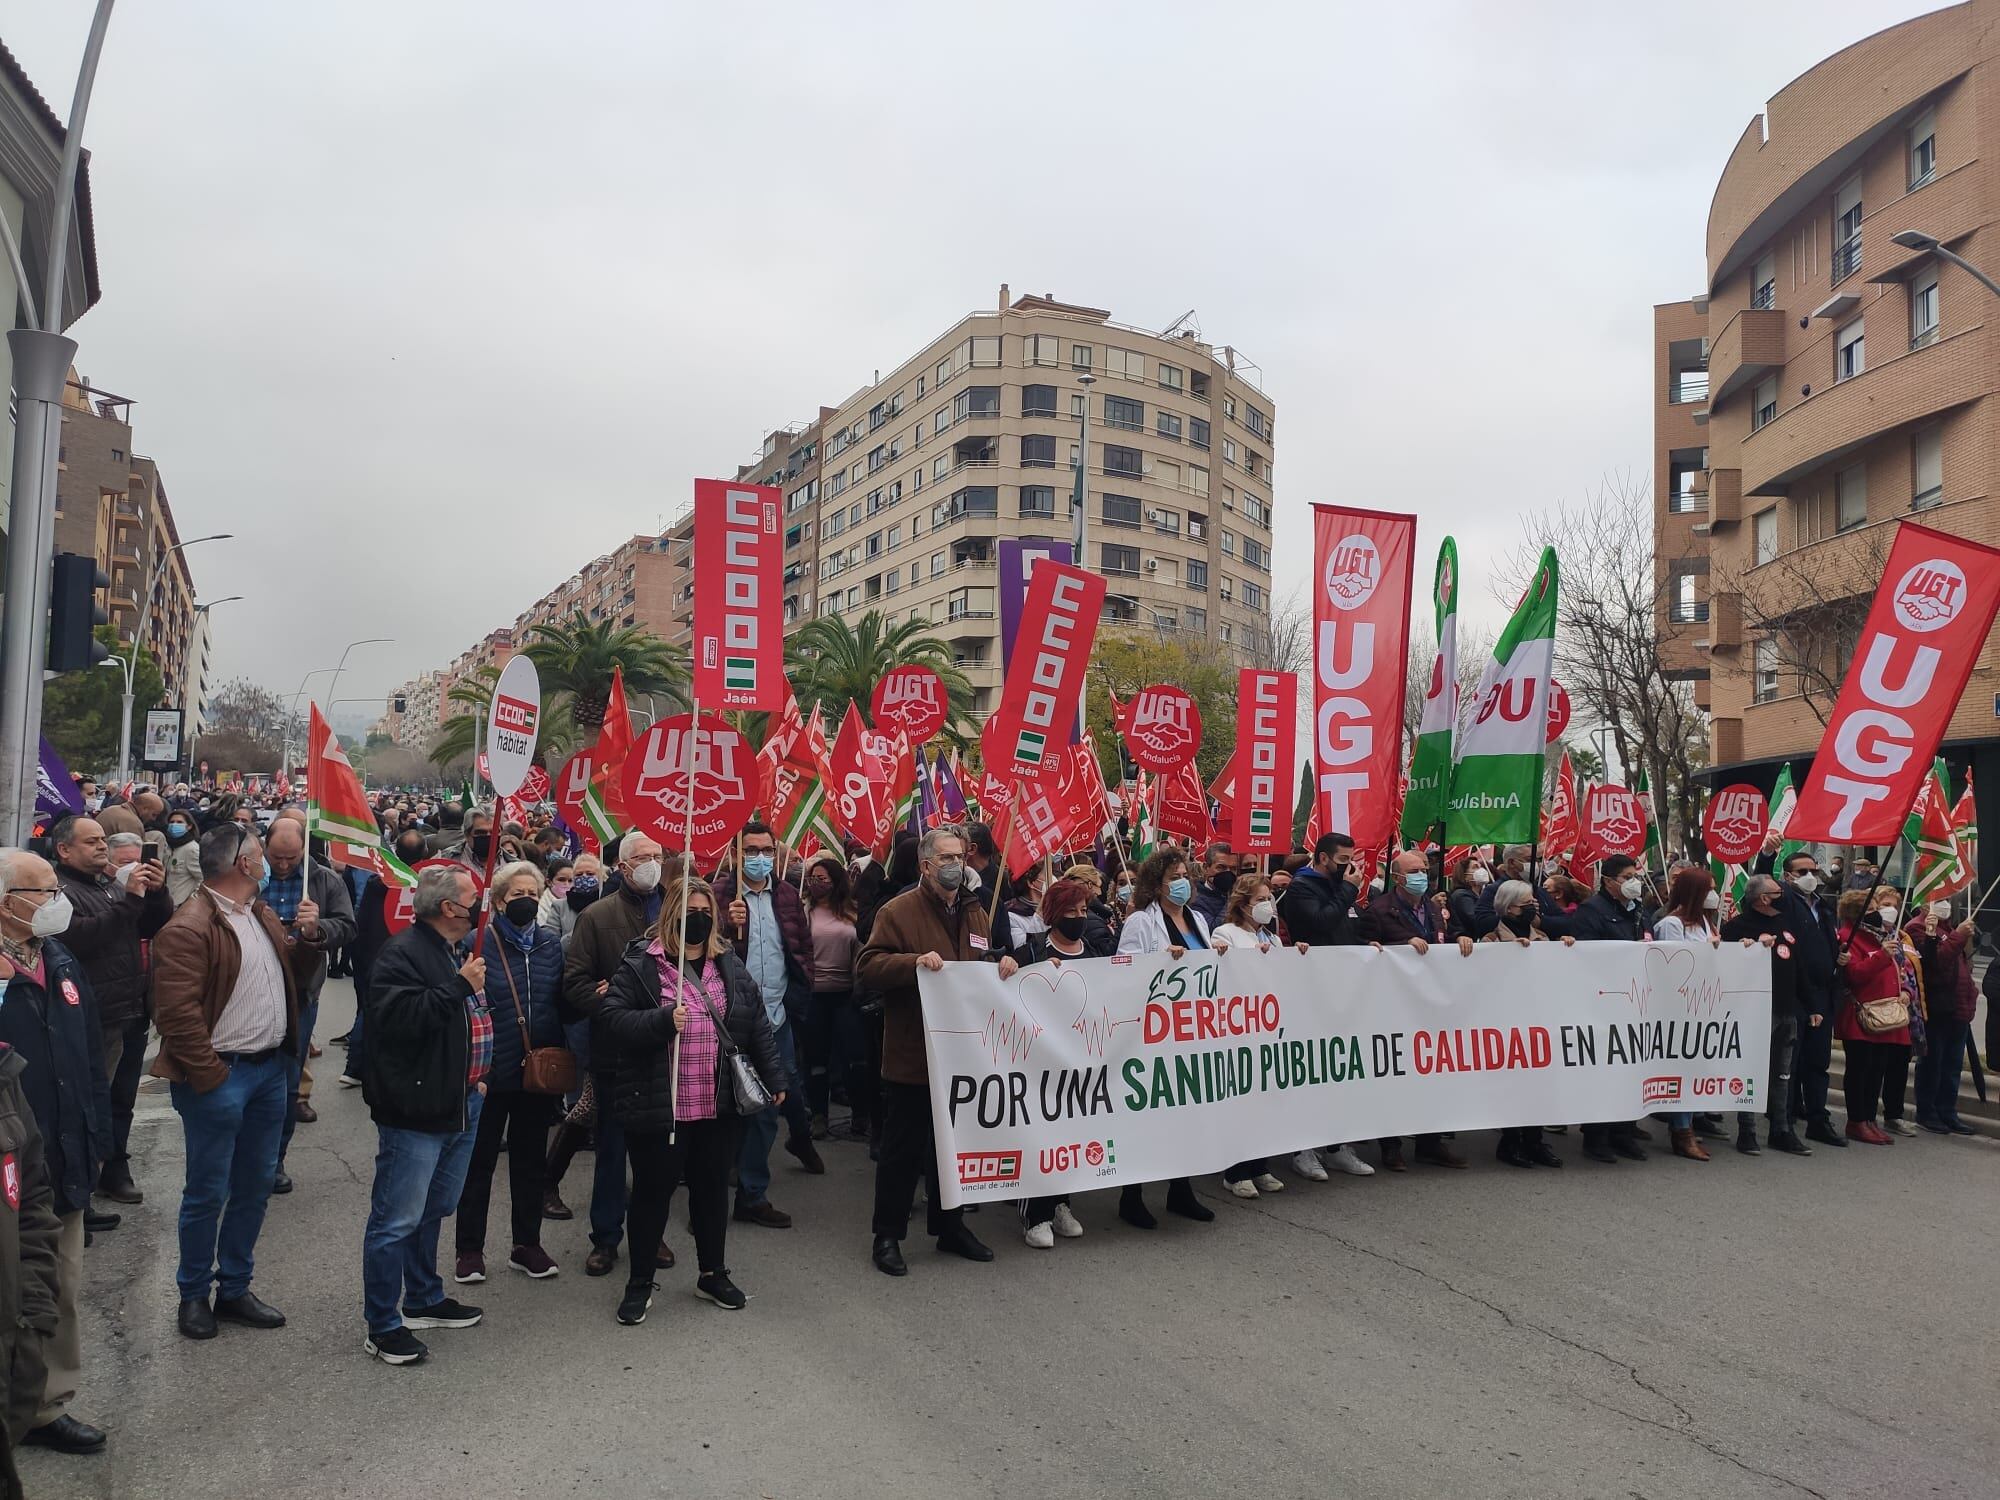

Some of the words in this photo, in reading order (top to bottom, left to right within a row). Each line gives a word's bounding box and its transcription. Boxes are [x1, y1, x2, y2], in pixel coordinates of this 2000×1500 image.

[726, 489, 758, 649] CCOO
[1334, 547, 1374, 578] UGT
[1906, 568, 1961, 605] UGT
[1023, 574, 1085, 727] CCOO
[723, 693, 757, 705] Jaén
[883, 675, 936, 705] UGT
[497, 702, 525, 725] CCOO
[1135, 693, 1190, 730] UGT
[1251, 675, 1279, 803] CCOO
[1318, 620, 1375, 836] UGT
[1824, 632, 1942, 839] UGT
[497, 731, 528, 756] hábitat
[643, 728, 739, 779] UGT
[1140, 749, 1181, 764] Andalucía
[1010, 763, 1039, 777] Jaén
[1591, 793, 1634, 823] UGT
[1715, 792, 1763, 823] UGT
[653, 816, 726, 836] Andalucía
[1248, 838, 1270, 847] Jaén
[1716, 843, 1751, 856] Andalucía
[1147, 966, 1188, 1003] ES
[1193, 963, 1219, 998] TU
[1144, 993, 1279, 1044] DERECHO
[949, 1072, 1030, 1128] POR
[1040, 1064, 1113, 1121] UNA
[1121, 1046, 1251, 1112] SANIDAD
[1260, 1028, 1365, 1092] PÚBLICA
[1372, 1033, 1406, 1078] DE
[1413, 1026, 1552, 1075] CALIDAD
[1560, 1025, 1597, 1067] EN
[1607, 1011, 1742, 1065] ANDALUCÍA
[1693, 1078, 1726, 1095] UGT
[1040, 1144, 1080, 1174] UGT
[1096, 1167, 1117, 1177] Jaén
[962, 1183, 986, 1192] vincial
[988, 1182, 998, 1190] de
[1000, 1181, 1019, 1189] Jaén
